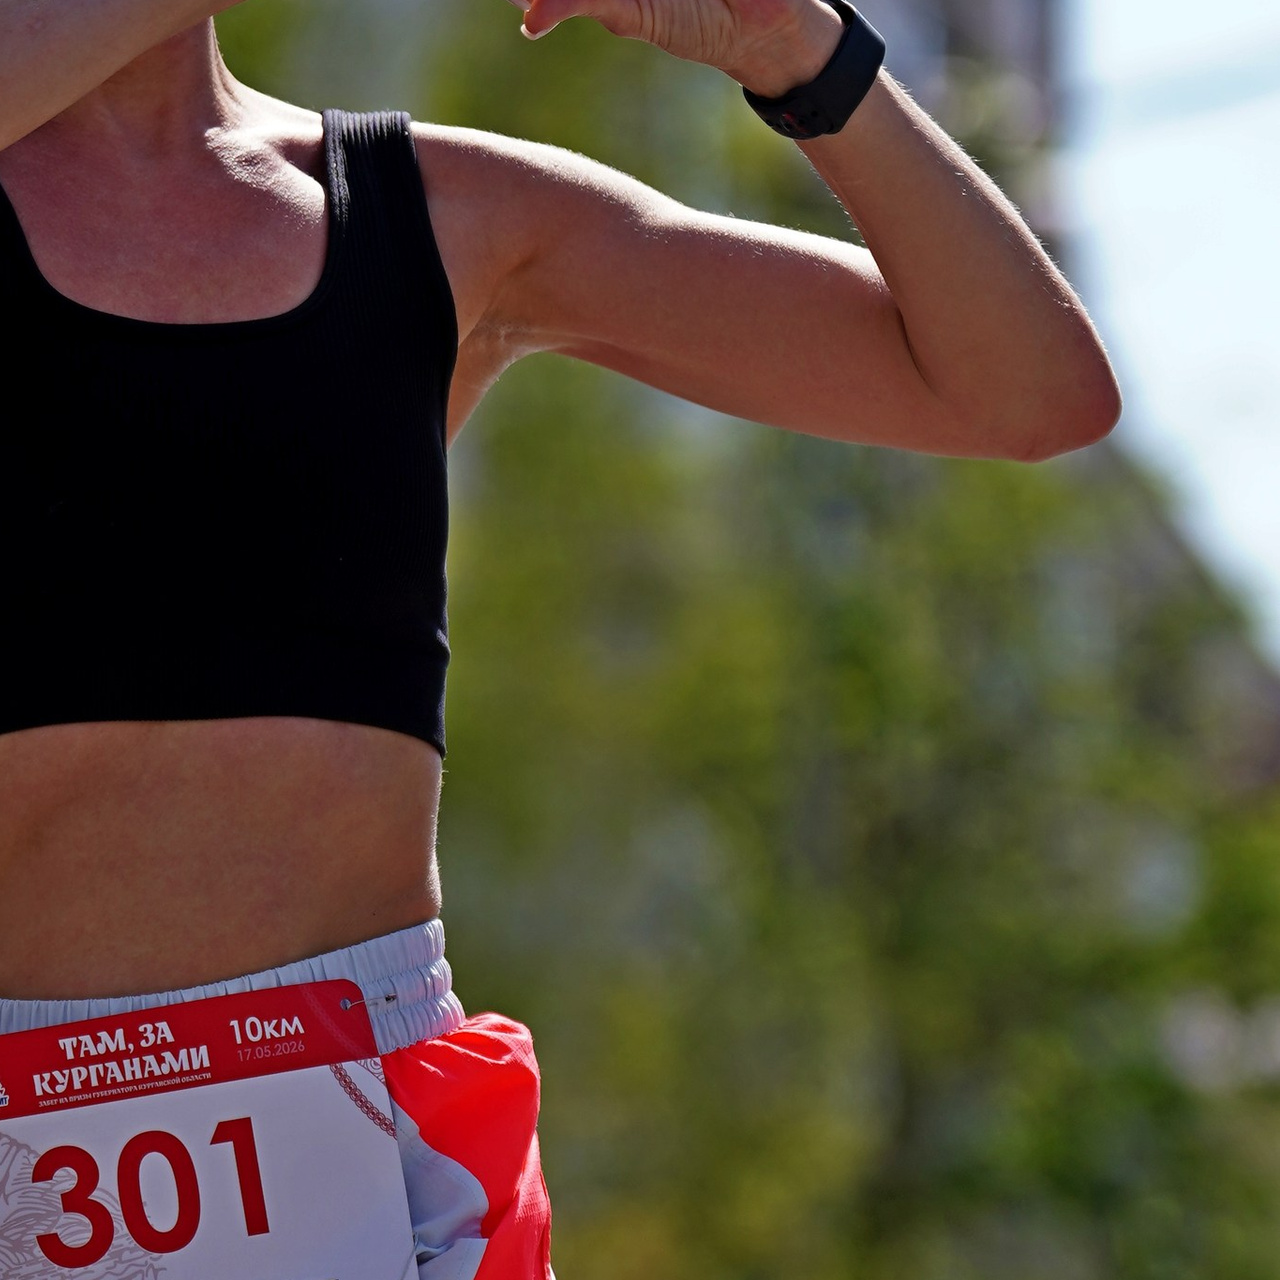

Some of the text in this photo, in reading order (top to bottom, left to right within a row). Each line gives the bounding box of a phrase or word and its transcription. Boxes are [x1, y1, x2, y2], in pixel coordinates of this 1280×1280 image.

[58, 1021, 175, 1060] ТАМ, ЗА
[237, 1040, 306, 1062] 17.05.2026
[32, 1044, 211, 1097] КУРГАНАМИ
[92, 1085, 138, 1099] ГУБЕРНАТОРА
[138, 1076, 181, 1091] КУРГАНСКОЙ
[181, 1072, 212, 1083] ОБЛАСТИ
[31, 1116, 270, 1269] 301
